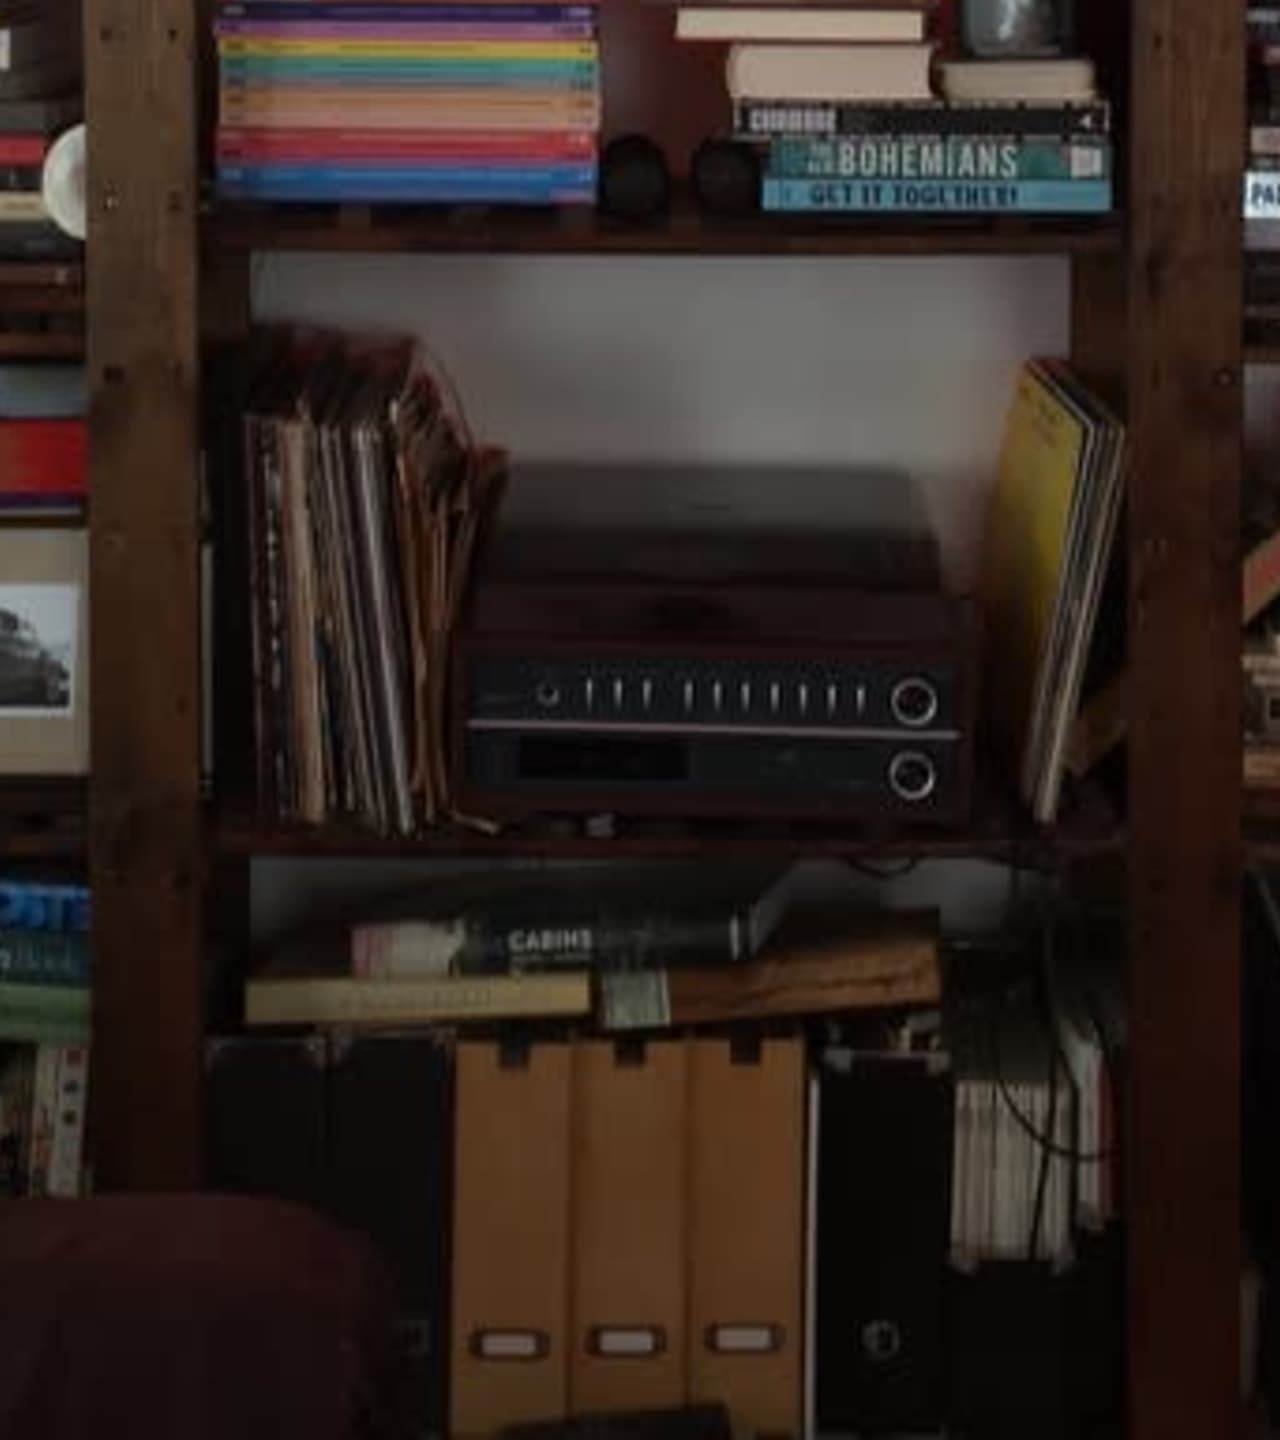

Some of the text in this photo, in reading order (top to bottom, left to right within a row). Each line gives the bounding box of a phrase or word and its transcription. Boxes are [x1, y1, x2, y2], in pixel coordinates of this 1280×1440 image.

[838, 143, 1020, 178] BOHEMIANS
[810, 184, 854, 207] GET
[860, 184, 884, 207] IT
[506, 930, 594, 953] CABINS
